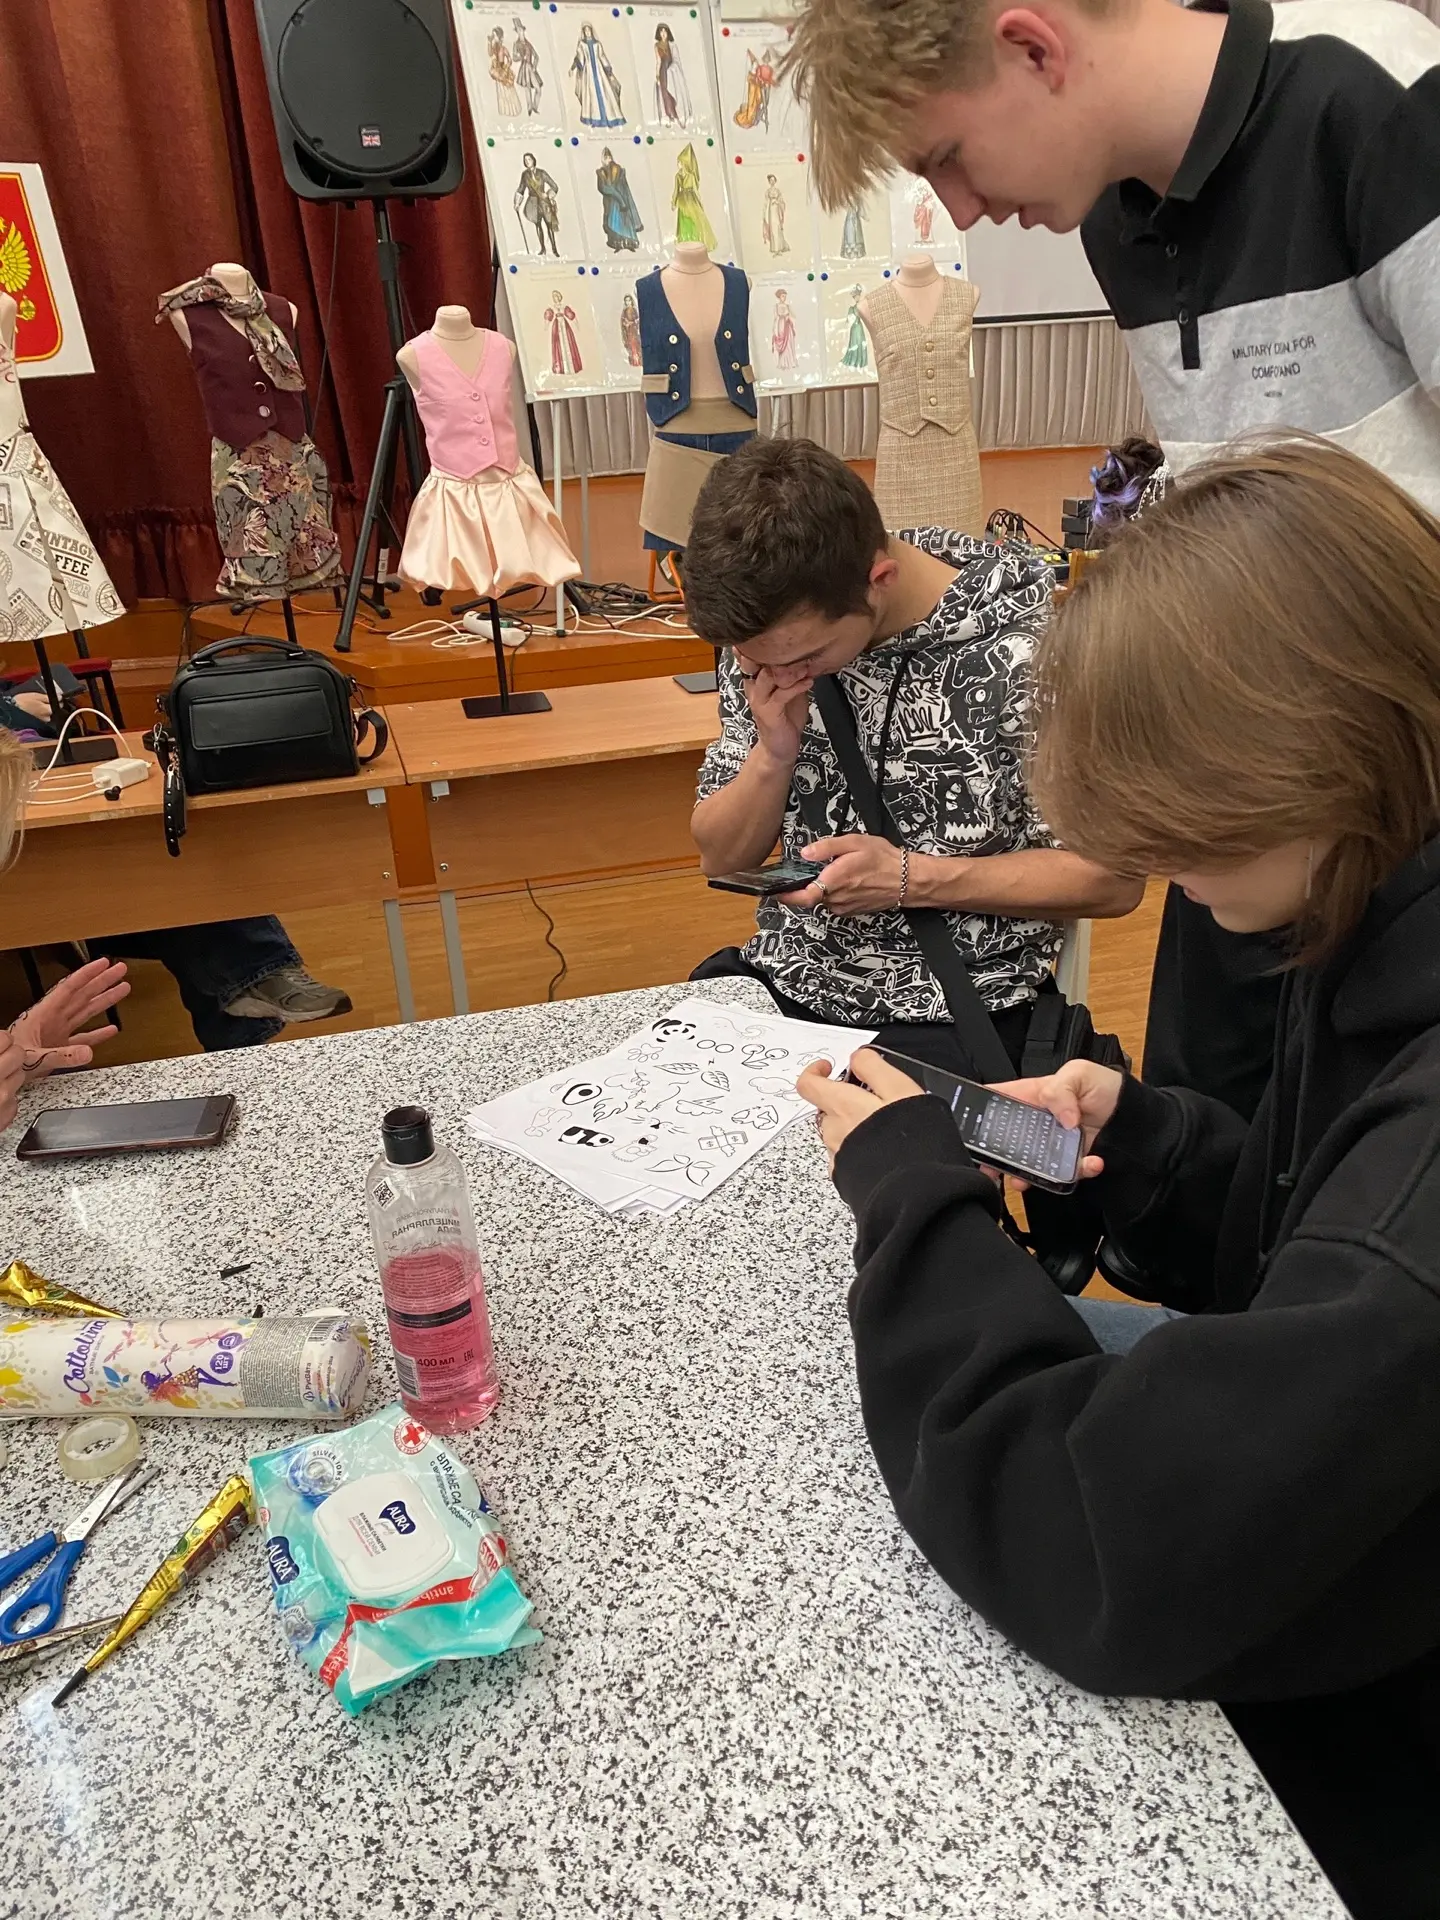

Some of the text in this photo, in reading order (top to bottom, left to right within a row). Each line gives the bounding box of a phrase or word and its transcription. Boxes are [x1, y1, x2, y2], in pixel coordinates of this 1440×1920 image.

[1292, 335, 1317, 352] FOR
[63, 1320, 110, 1394] Cottolina
[215, 1354, 224, 1370] 120
[417, 1357, 455, 1367] 400 мл
[312, 1450, 337, 1460] SILVER
[386, 1506, 411, 1532] AURA
[267, 1544, 293, 1580] AURA
[480, 1541, 498, 1571] STOP
